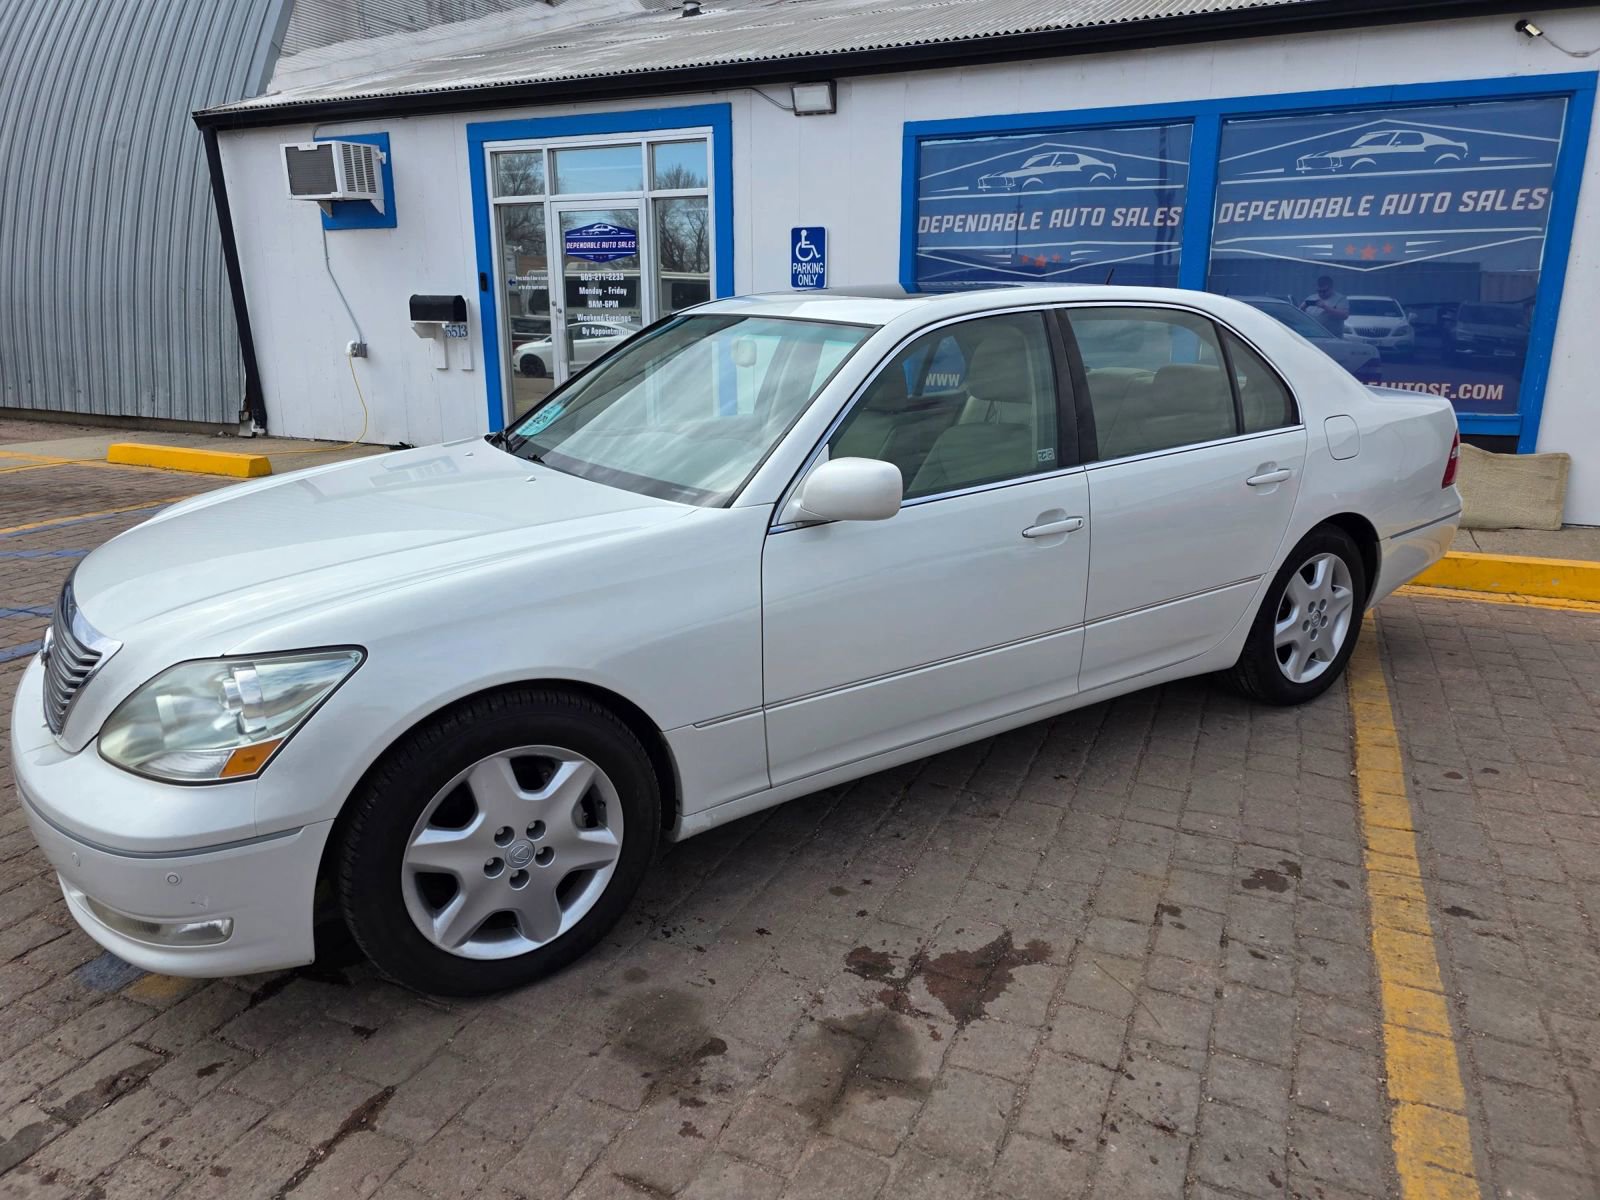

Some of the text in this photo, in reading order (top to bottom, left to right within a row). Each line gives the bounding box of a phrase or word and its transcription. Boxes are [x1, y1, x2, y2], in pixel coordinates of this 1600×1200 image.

[1218, 188, 1548, 224] DEPENDABLE AUTO SALES
[918, 207, 1182, 234] DEPENDABLE AUTO SALES
[792, 262, 824, 274] PARKING
[797, 274, 818, 286] ONLY
[578, 287, 603, 296] Monday
[608, 286, 627, 296] Friday
[445, 324, 468, 338] 5513
